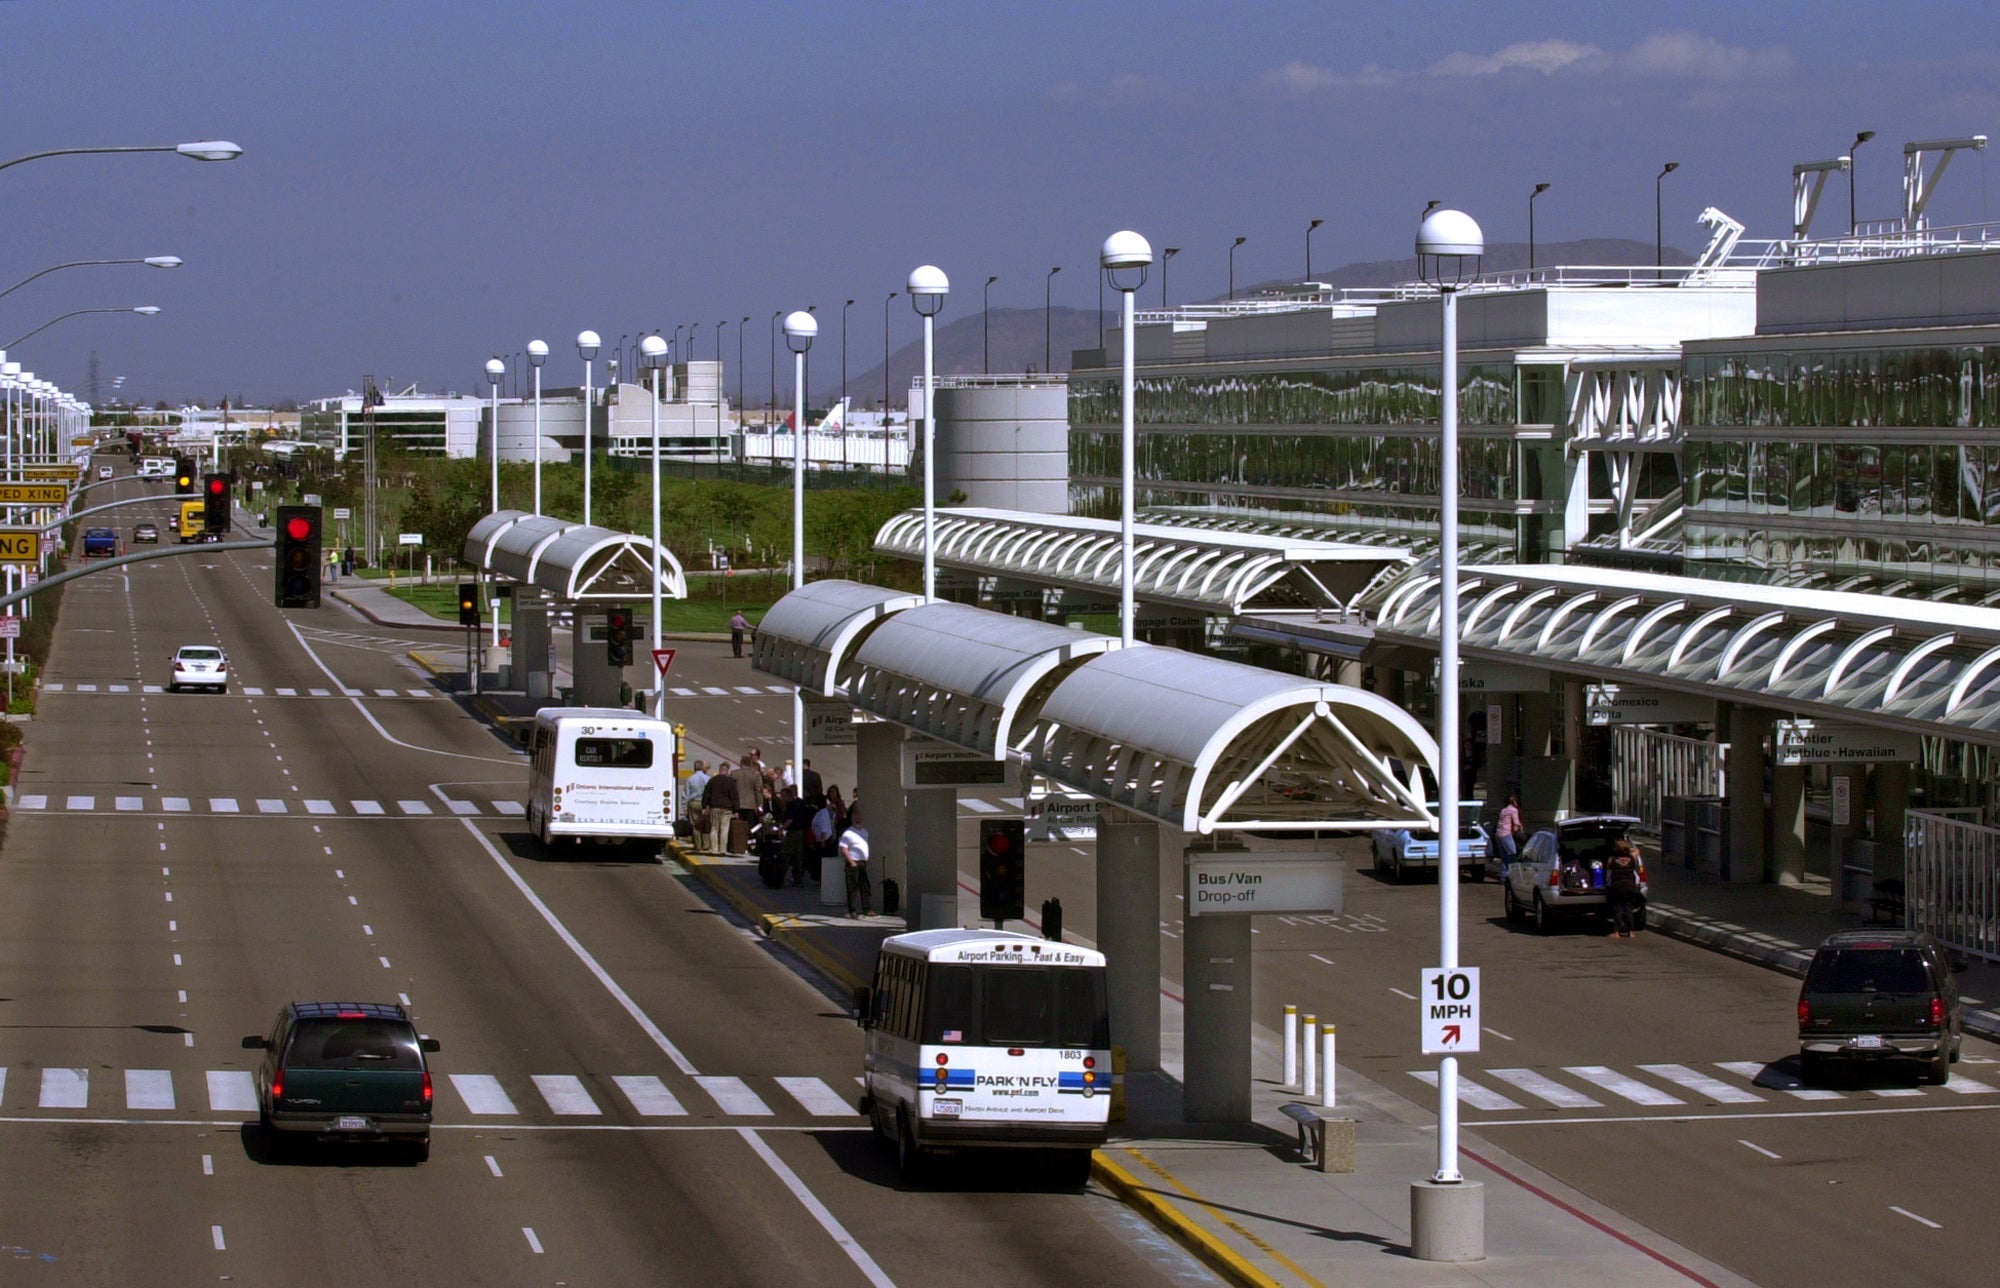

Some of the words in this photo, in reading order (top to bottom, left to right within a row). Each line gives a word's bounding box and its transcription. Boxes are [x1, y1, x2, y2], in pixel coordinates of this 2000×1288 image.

[0, 489, 21, 499] ED
[28, 489, 61, 499] XING
[0, 539, 29, 554] NG
[1048, 603, 1090, 614] Baggage
[1091, 602, 1118, 612] Claim
[1133, 618, 1167, 628] ggage
[1169, 617, 1201, 627] Claim
[1592, 696, 1659, 707] Aeromexico
[1592, 710, 1621, 719] Delta
[581, 726, 595, 735] 30
[1783, 733, 1834, 745] Frontier
[1783, 747, 1830, 758] Jetblue
[1838, 746, 1896, 757] Hawaiian
[1047, 802, 1090, 814] Airport
[1198, 872, 1262, 885] Bus/Van
[1198, 890, 1256, 904] Drop-off
[958, 951, 988, 963] Airport
[1034, 951, 1053, 962] Fast
[1054, 952, 1061, 962] &
[1063, 952, 1086, 965] Easy
[1431, 973, 1471, 1001] 10
[1430, 1004, 1471, 1019] MPH
[1059, 1050, 1082, 1060] 1803
[976, 1076, 1013, 1086] PARK
[1016, 1076, 1029, 1087] 'N
[1032, 1076, 1057, 1088] FLY
